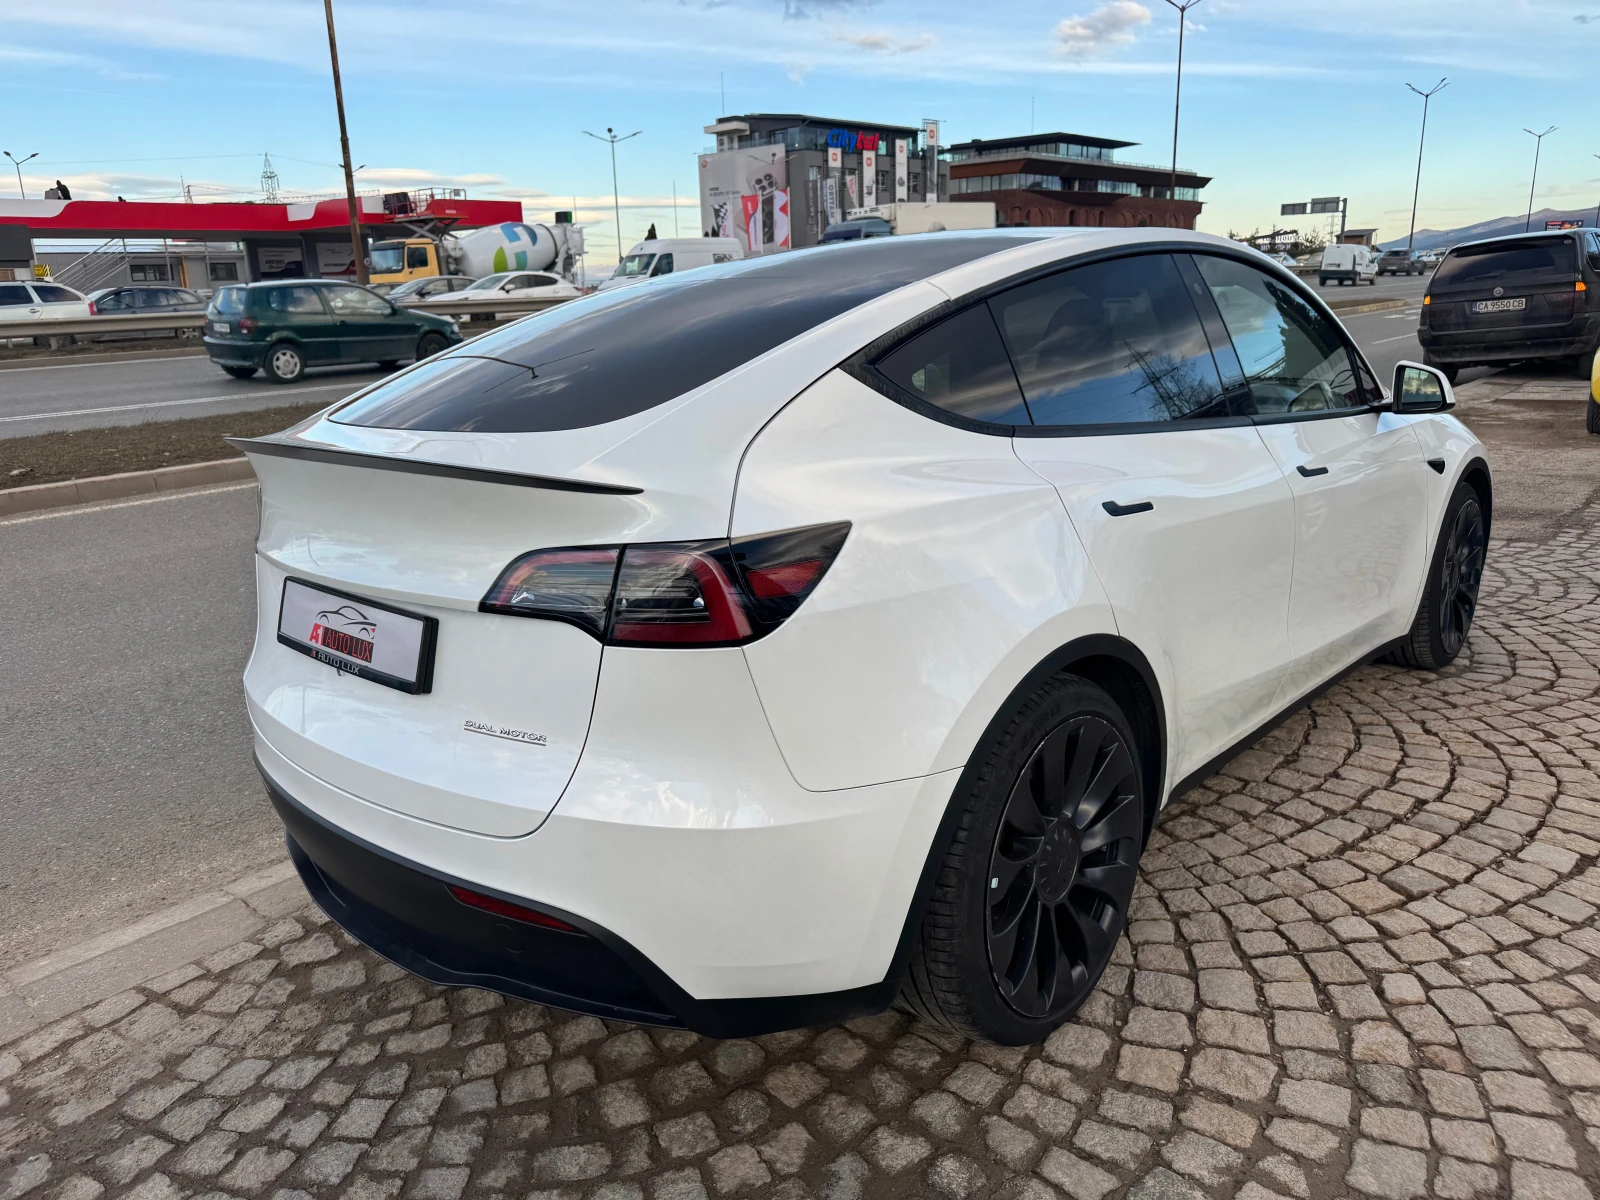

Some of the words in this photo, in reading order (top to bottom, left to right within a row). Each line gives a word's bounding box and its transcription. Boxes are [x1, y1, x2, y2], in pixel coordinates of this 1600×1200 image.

[1477, 302, 1489, 311] CA
[1490, 300, 1511, 309] 9550
[1512, 299, 1524, 308] CB
[325, 629, 351, 653] AUTO
[352, 637, 373, 662] LUX
[319, 652, 339, 667] AUTO
[342, 661, 359, 674] LUX
[464, 720, 497, 733] DUAL
[500, 727, 547, 742] MOTOR
